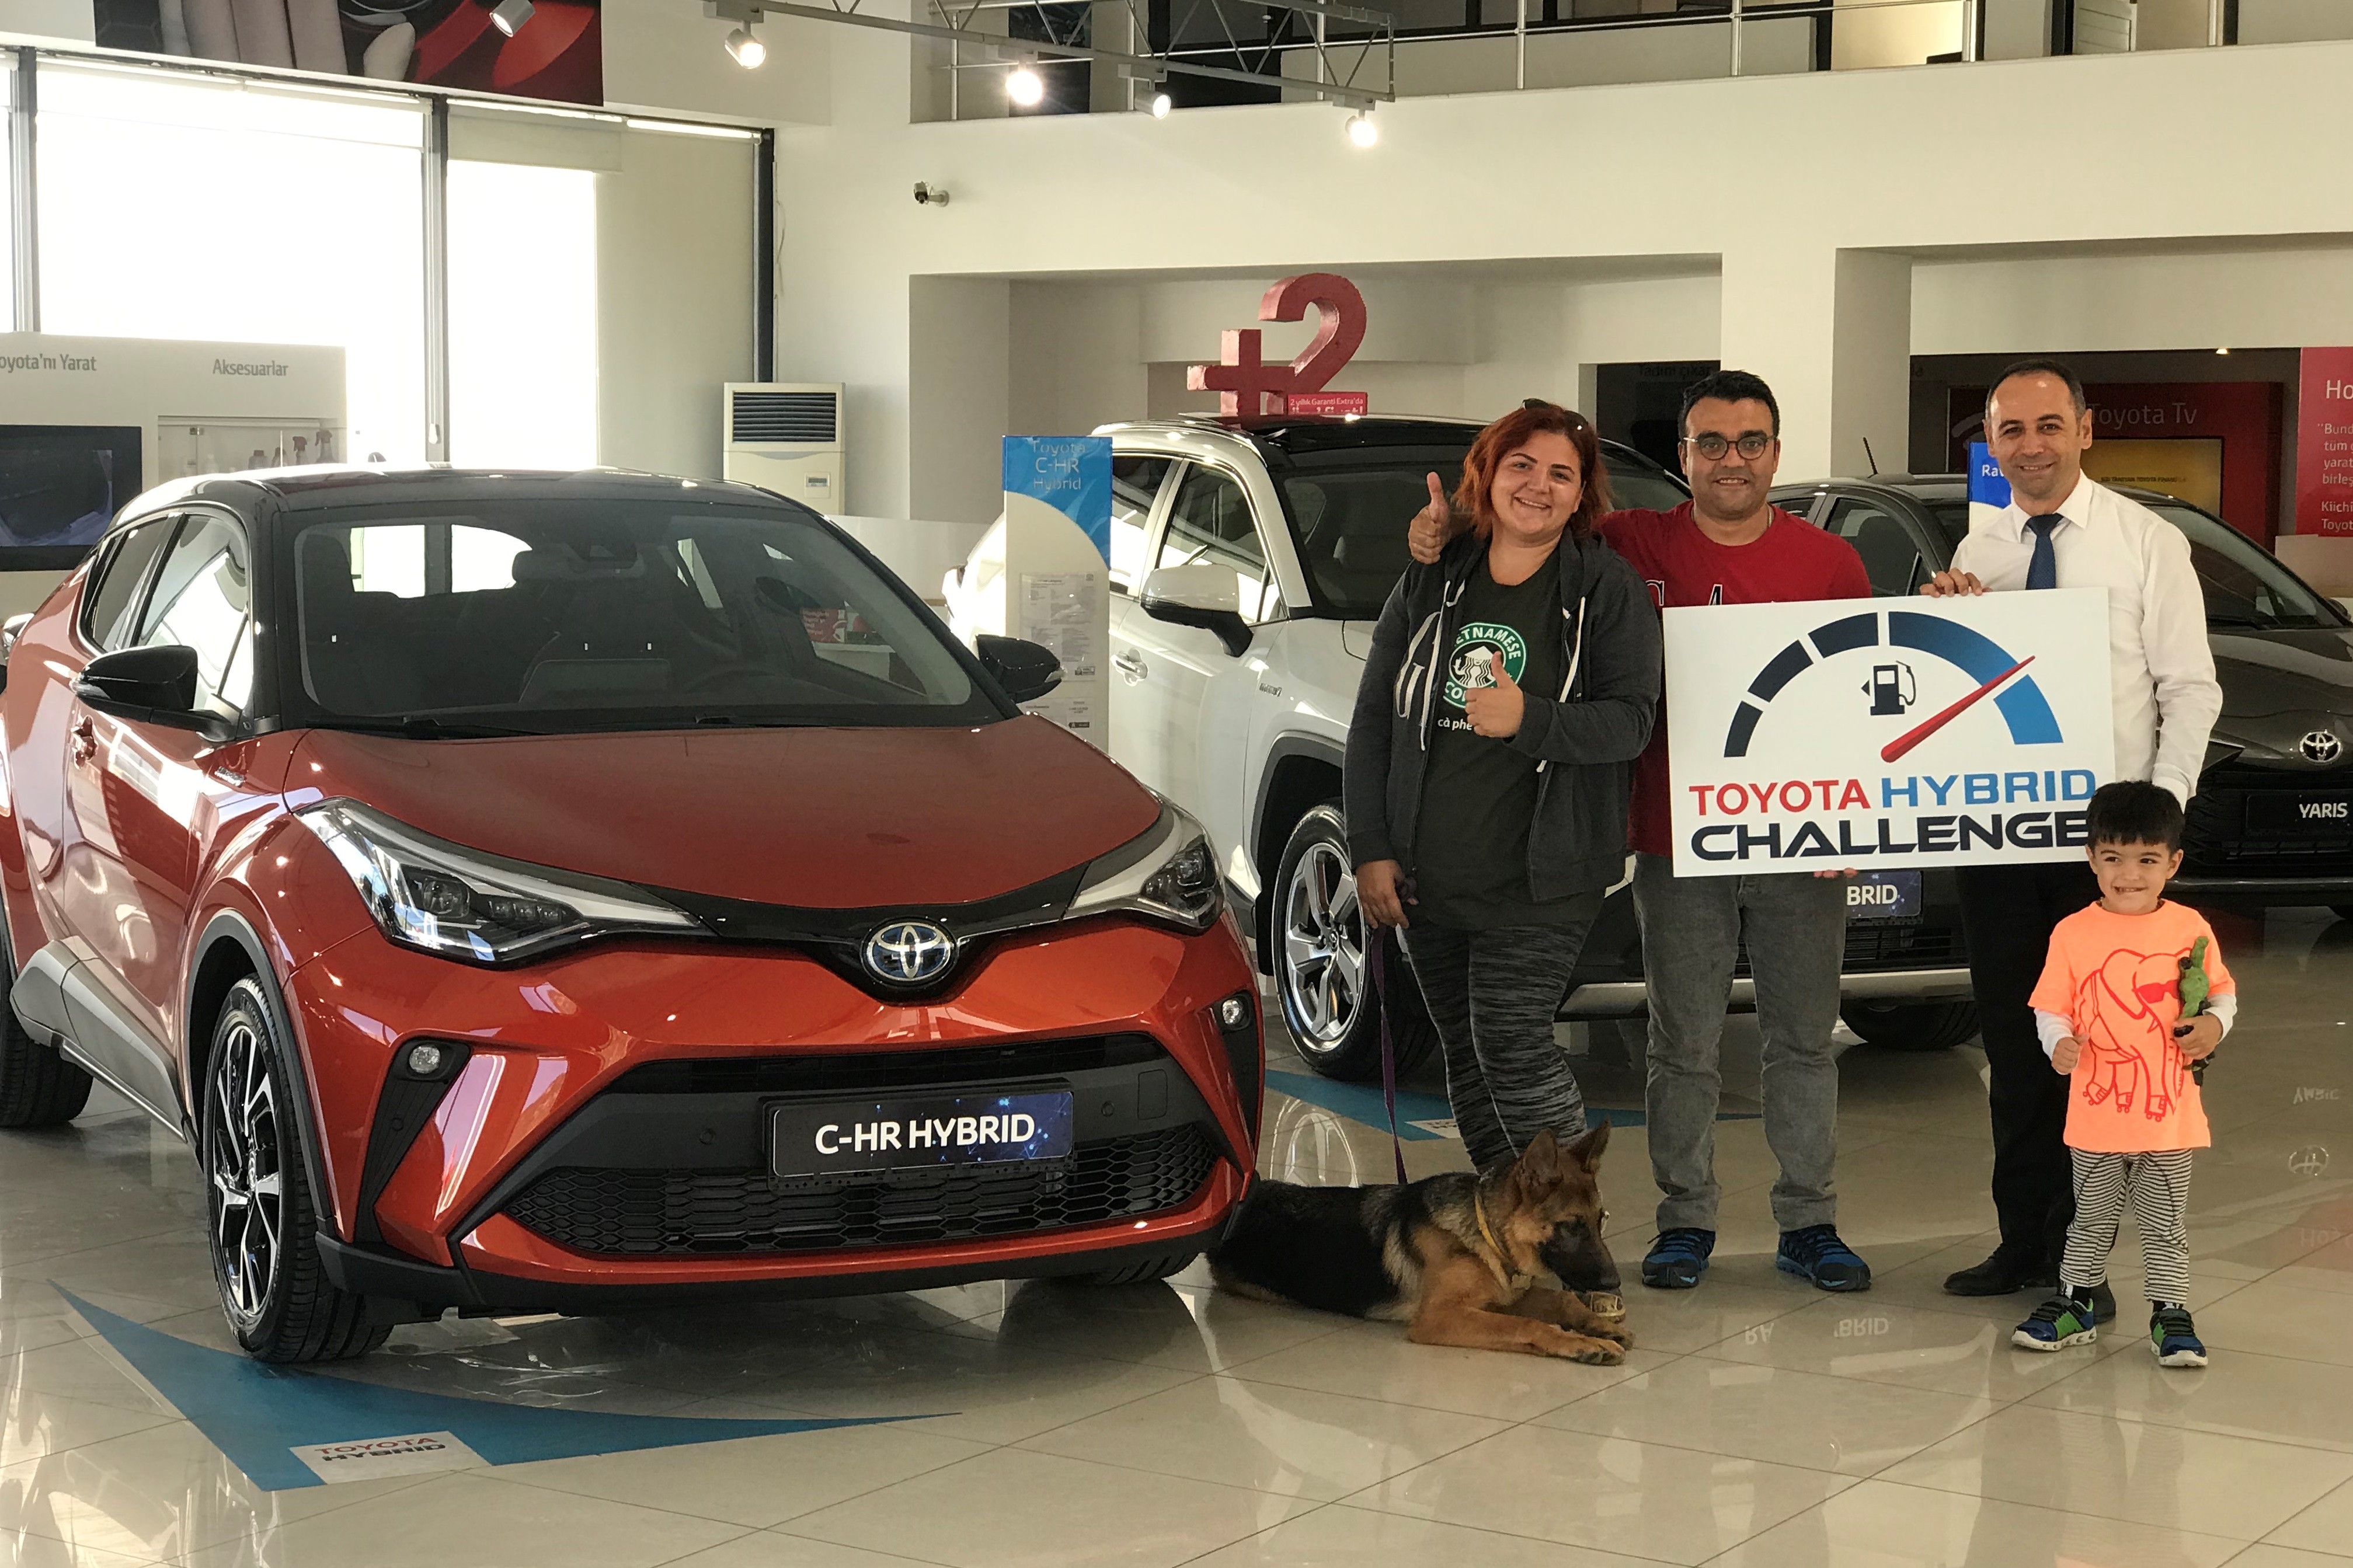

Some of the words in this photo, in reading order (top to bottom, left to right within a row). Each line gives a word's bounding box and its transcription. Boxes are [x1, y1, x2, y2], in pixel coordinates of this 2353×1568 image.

[60, 354, 97, 371] Yarat
[213, 358, 289, 377] Aksesuarlar
[2086, 403, 2165, 430] Toyota
[2171, 402, 2197, 424] Tv
[1031, 440, 1085, 457] Toyota
[1035, 457, 1080, 473] C-HR
[1033, 477, 1081, 493] Hybrid
[1454, 627, 1522, 660] ETNAMESE
[1689, 778, 1871, 816] TOYOTA
[1881, 768, 2097, 809] HYBRID
[2299, 802, 2348, 818] YARIS
[1691, 811, 2092, 862] CHALLENGE
[1847, 884, 1898, 906] BRID
[815, 1121, 902, 1155] C-HR
[909, 1113, 1036, 1150] HYBRID
[314, 1437, 439, 1454] TOYOTA
[322, 1443, 446, 1461] HYBRID
